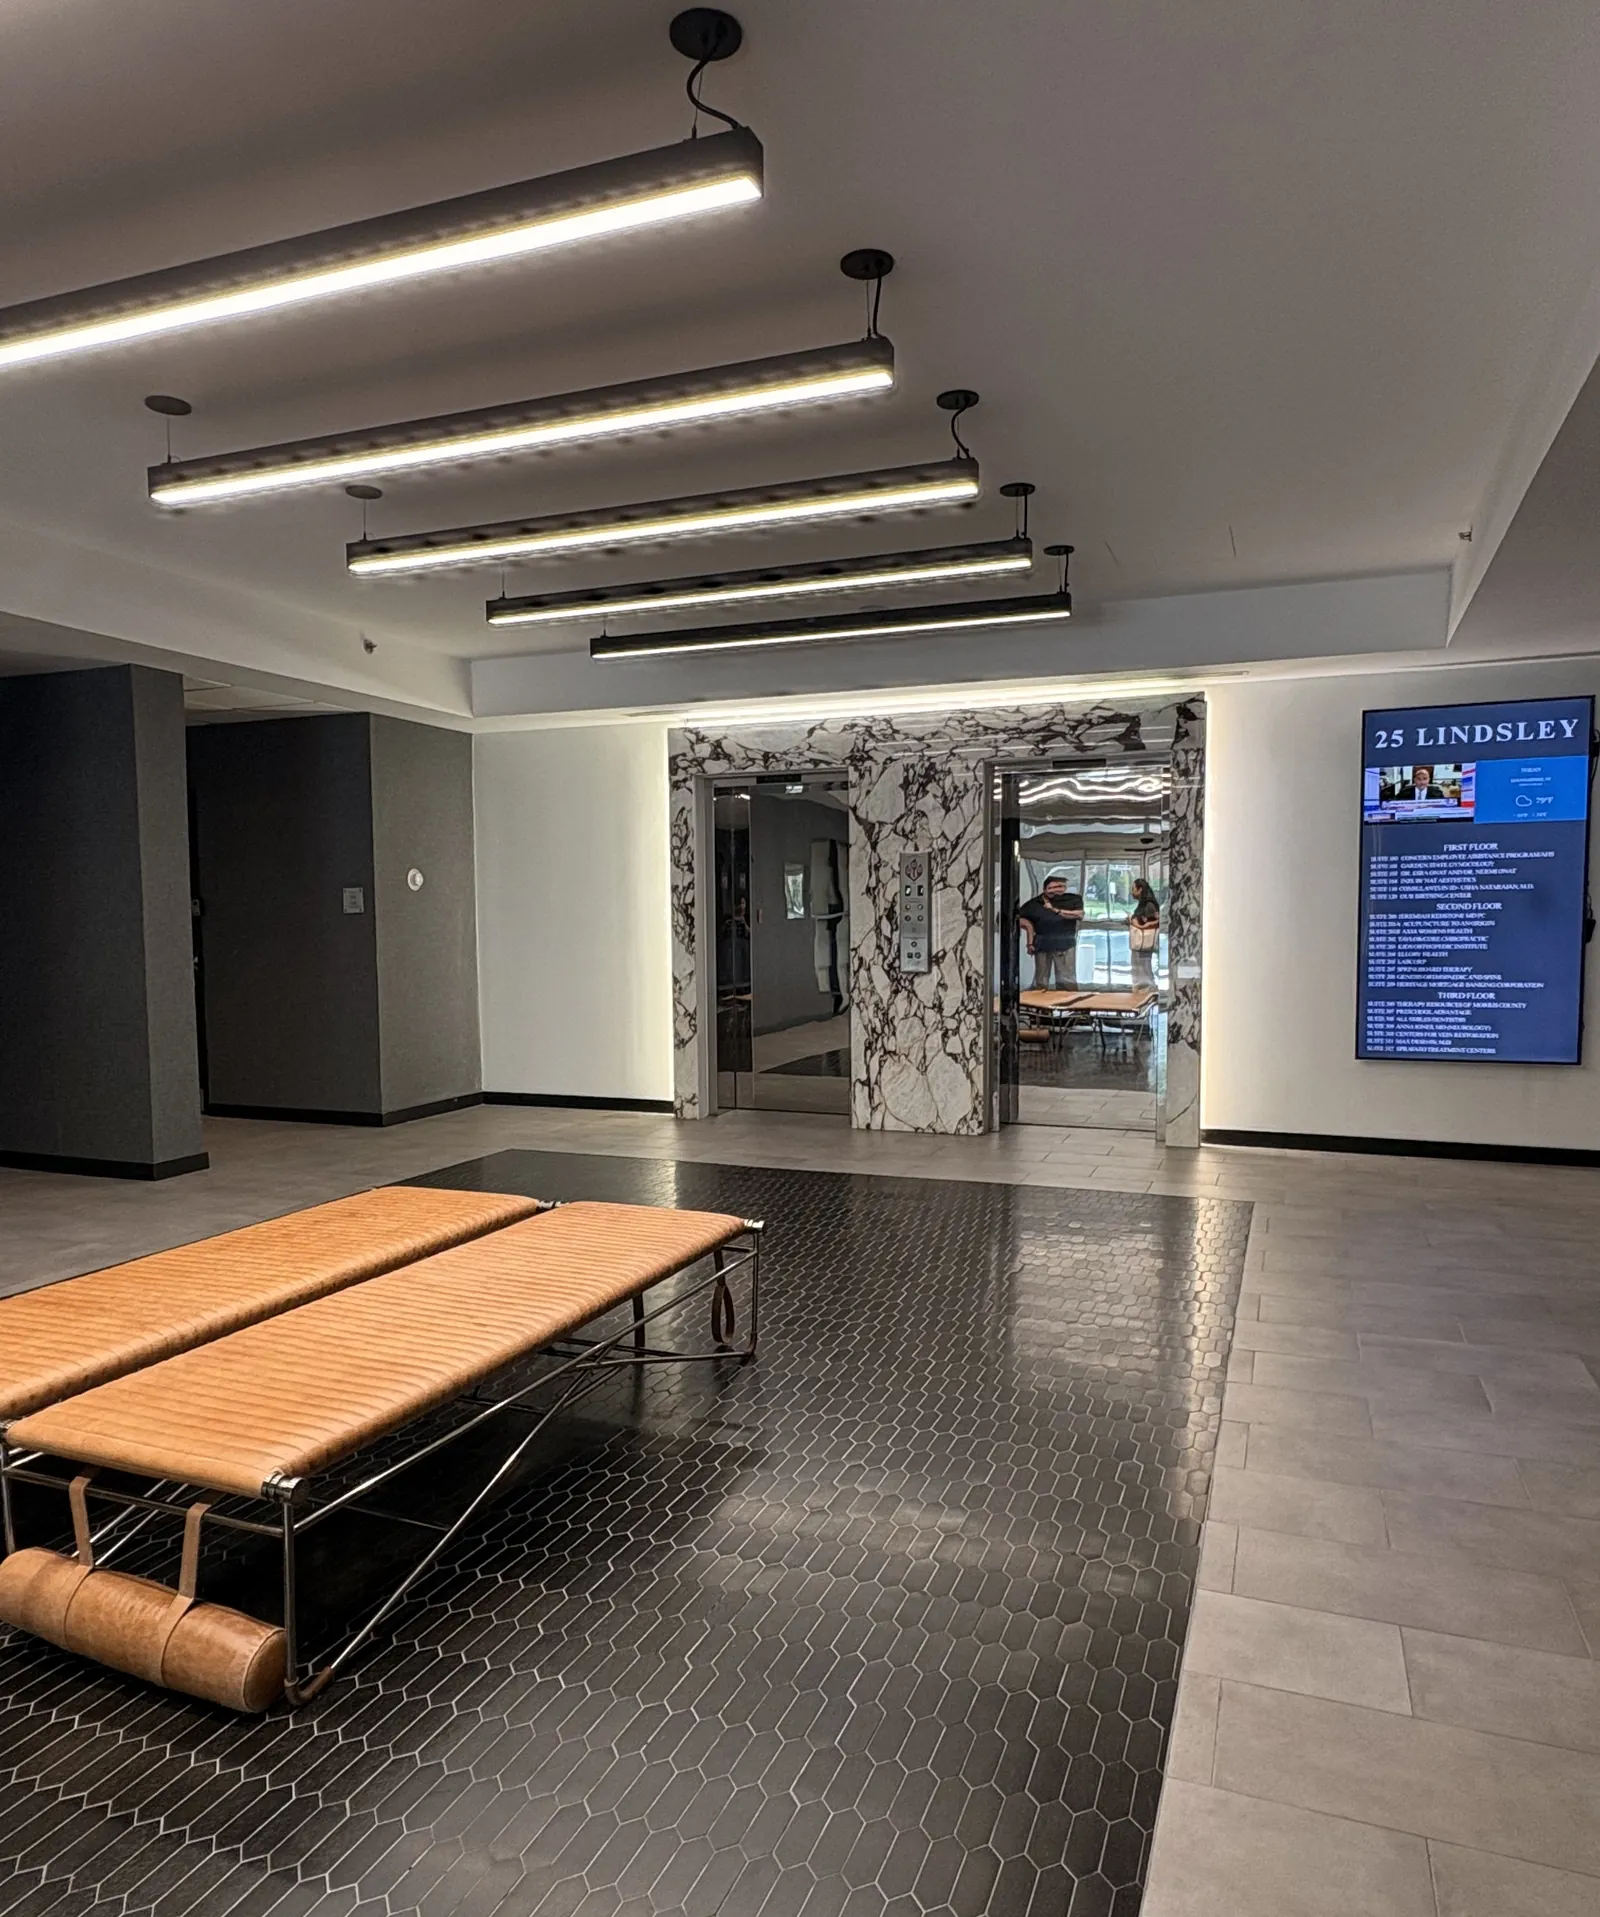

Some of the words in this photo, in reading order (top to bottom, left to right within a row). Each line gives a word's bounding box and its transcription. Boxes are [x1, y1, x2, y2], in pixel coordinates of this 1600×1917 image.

[1375, 730, 1404, 748] 25
[1416, 719, 1579, 746] LINDSLEY
[1443, 844, 1468, 852] FIRST
[1469, 843, 1499, 851] FLOOR
[1436, 903, 1472, 911] SECOND
[1472, 902, 1503, 910] FLOOR
[1437, 992, 1466, 1000] THIRD
[1466, 992, 1496, 1000] FLOOR
